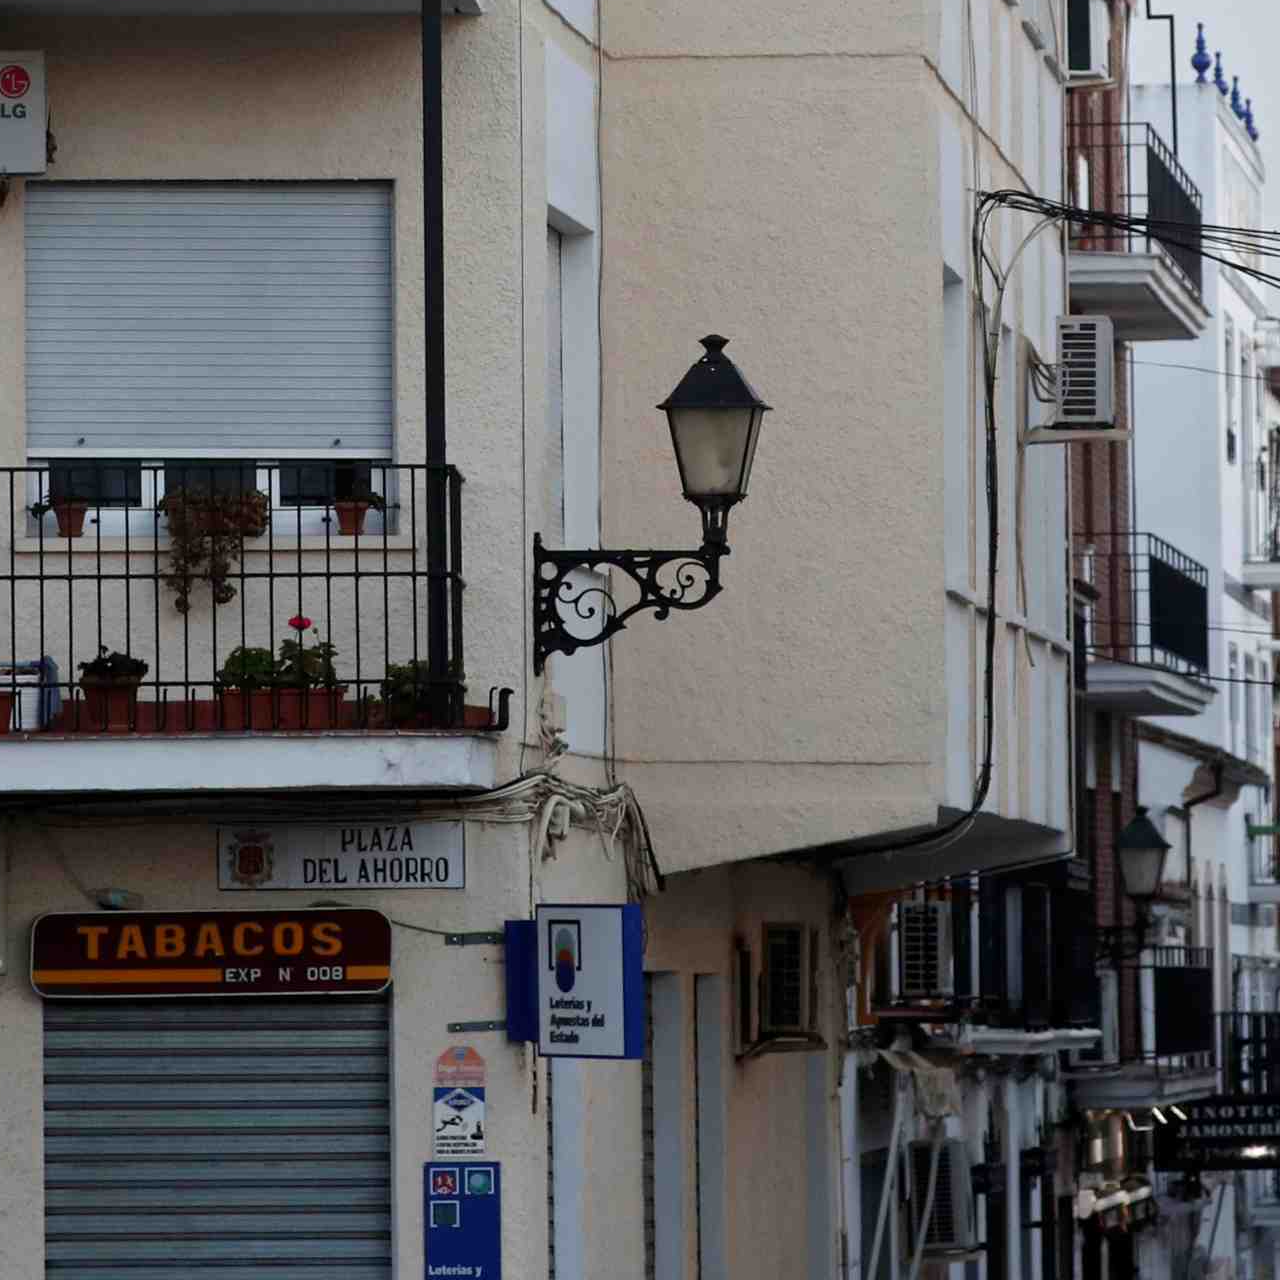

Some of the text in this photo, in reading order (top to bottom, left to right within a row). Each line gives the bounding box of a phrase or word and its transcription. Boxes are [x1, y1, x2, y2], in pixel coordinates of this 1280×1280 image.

[0, 104, 27, 119] LG
[341, 826, 414, 852] PLAZA
[303, 857, 450, 884] DEL AHORRO
[77, 921, 344, 961] TABACOS
[224, 967, 262, 983] EXP
[306, 965, 344, 981] 008
[586, 1000, 593, 1012] y
[475, 1266, 483, 1278] y
